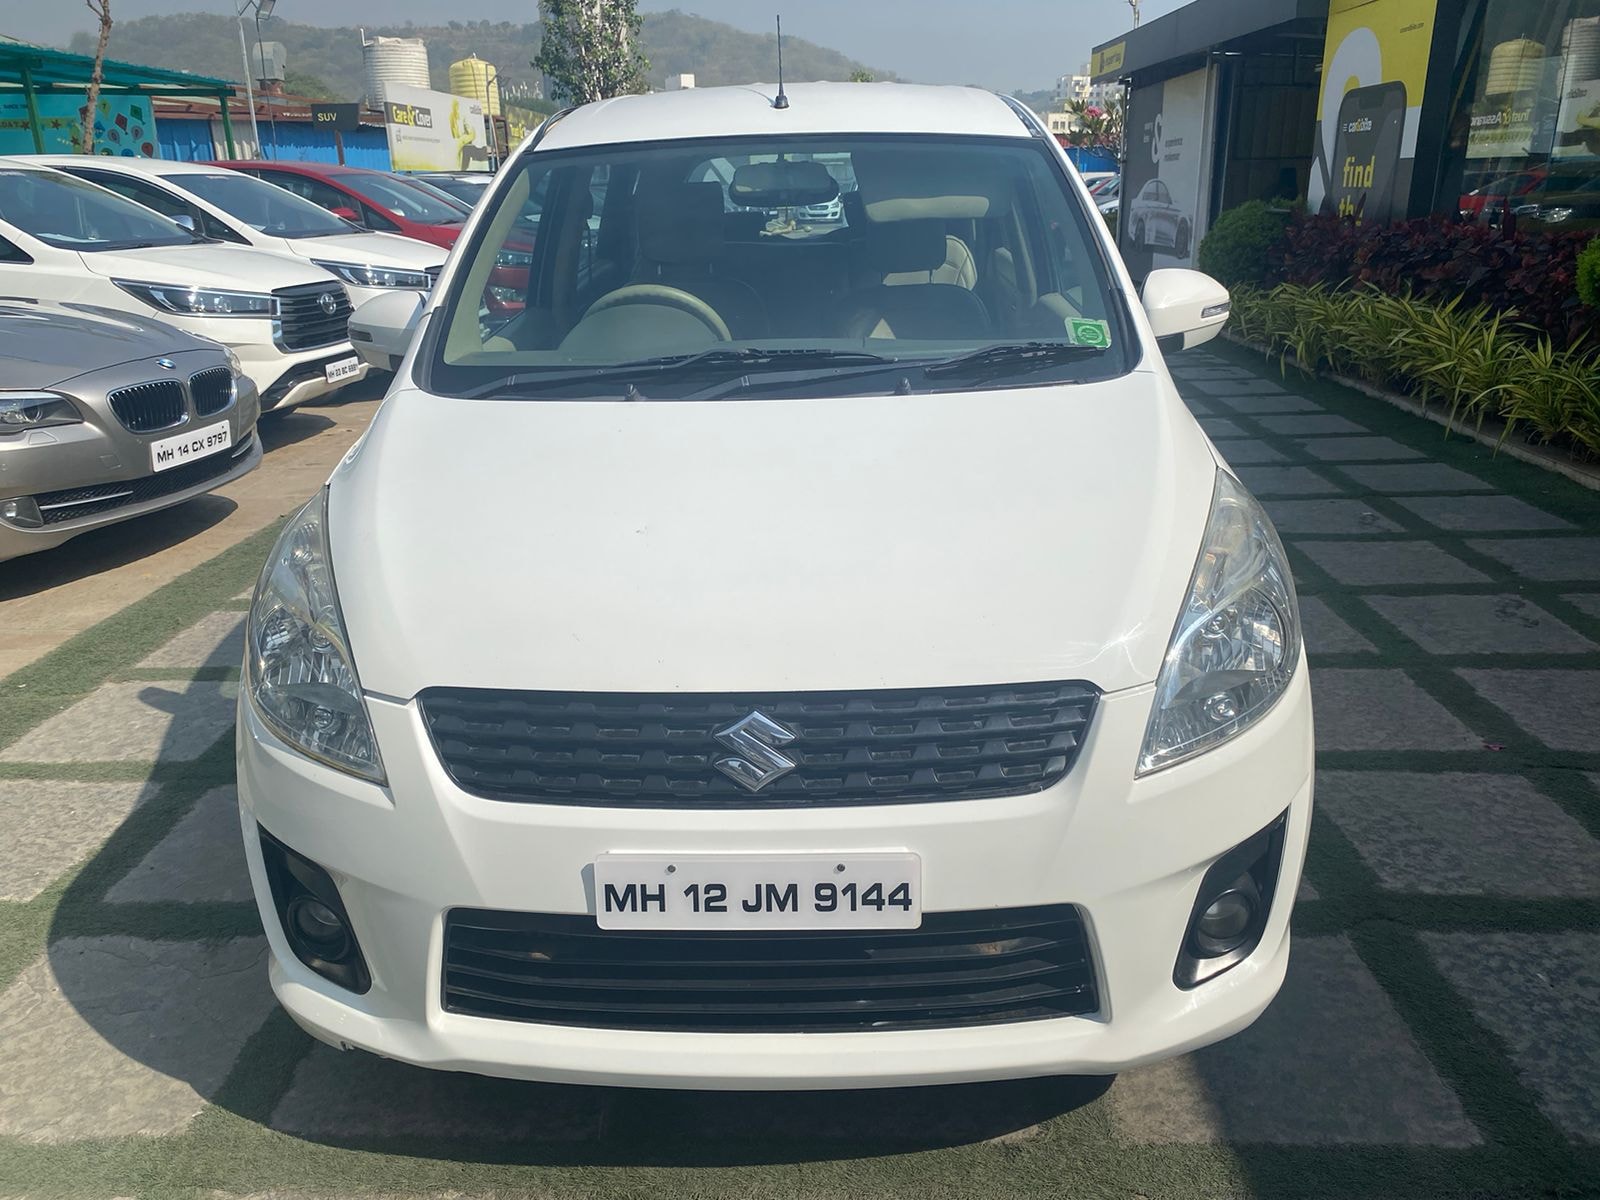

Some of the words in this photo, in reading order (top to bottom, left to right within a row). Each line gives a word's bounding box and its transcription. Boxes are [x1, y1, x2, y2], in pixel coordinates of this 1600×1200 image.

[317, 112, 337, 121] SUV
[1342, 154, 1376, 188] find
[157, 448, 174, 463] MH
[178, 444, 189, 456] 14
[191, 438, 205, 453] CX
[206, 431, 227, 447] 9797
[604, 883, 666, 913] MH
[683, 883, 728, 913] 12
[741, 883, 798, 913] JM
[814, 882, 912, 912] 9144
